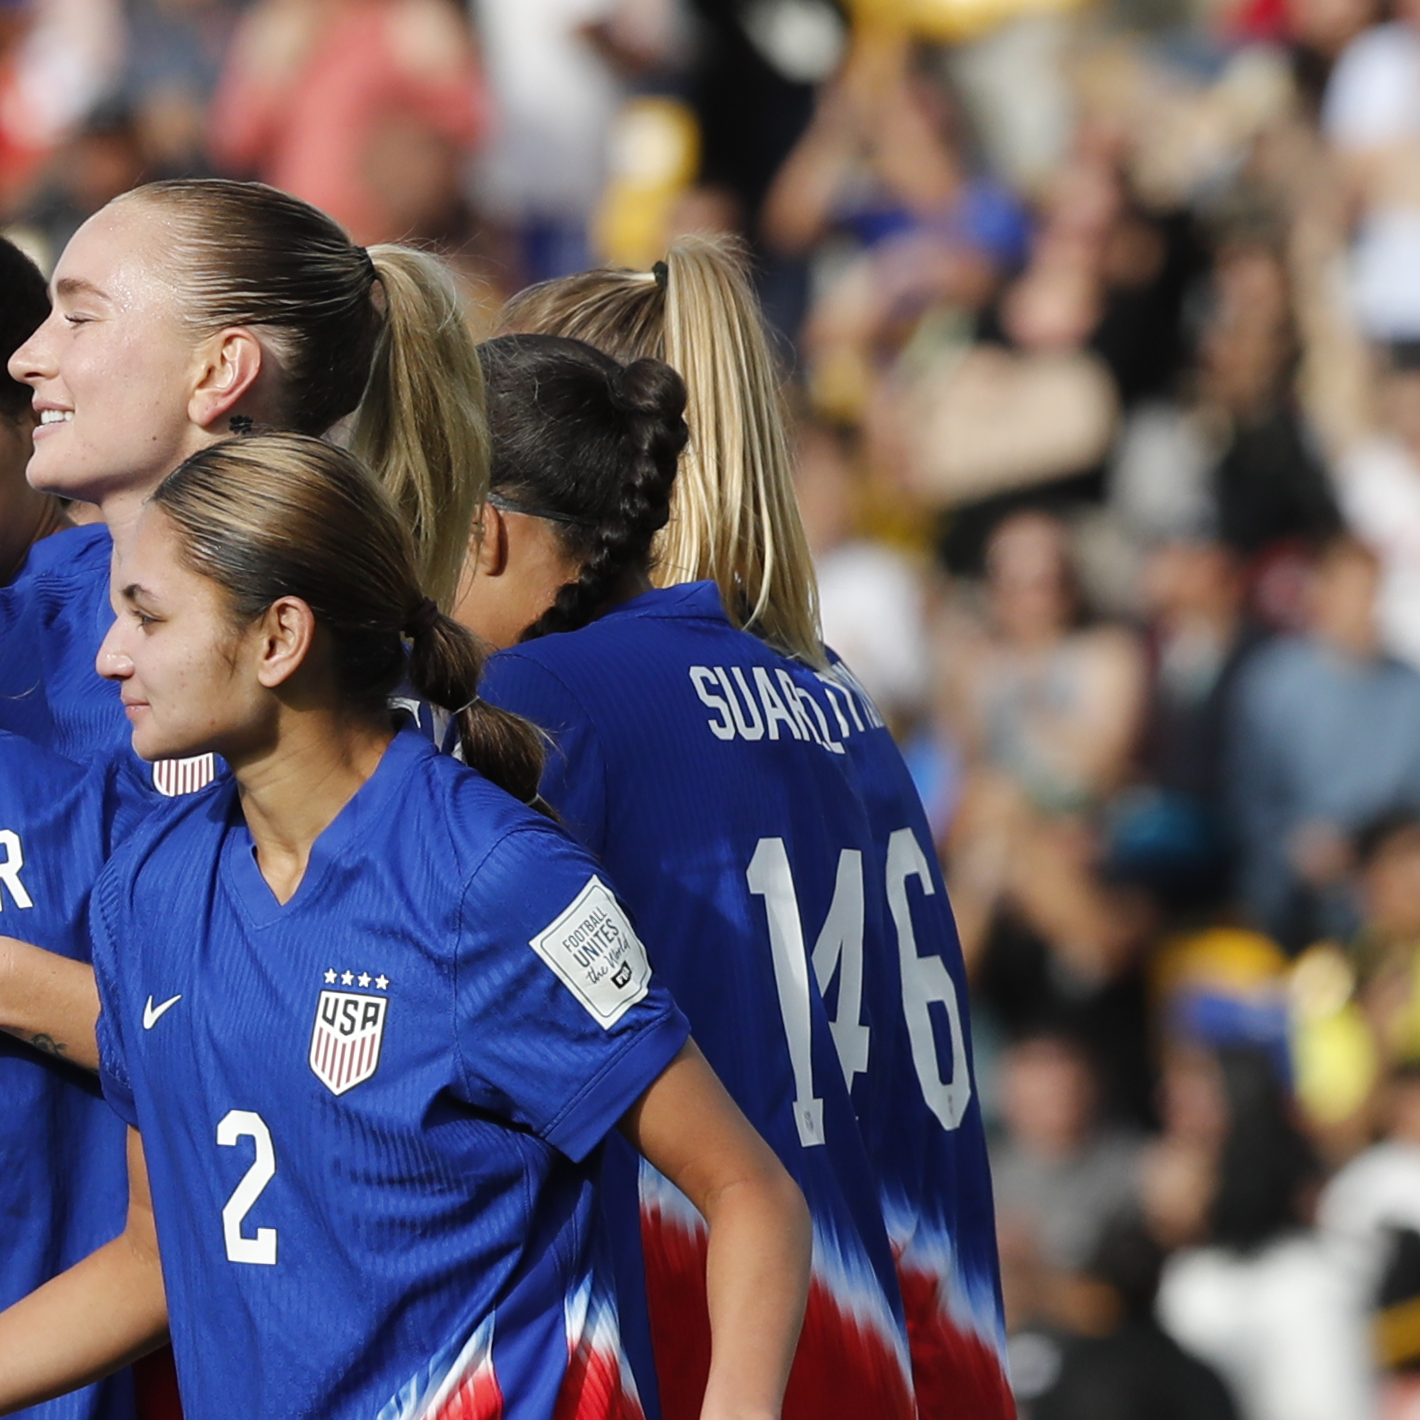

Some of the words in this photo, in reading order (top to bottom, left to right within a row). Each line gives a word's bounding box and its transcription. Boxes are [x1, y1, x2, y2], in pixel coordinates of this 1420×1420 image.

[562, 906, 608, 953] FOOTBALL
[572, 918, 619, 968] UNITES
[584, 965, 609, 985] the
[603, 932, 631, 969] World
[321, 996, 382, 1036] USA
[216, 1109, 277, 1265] 2
